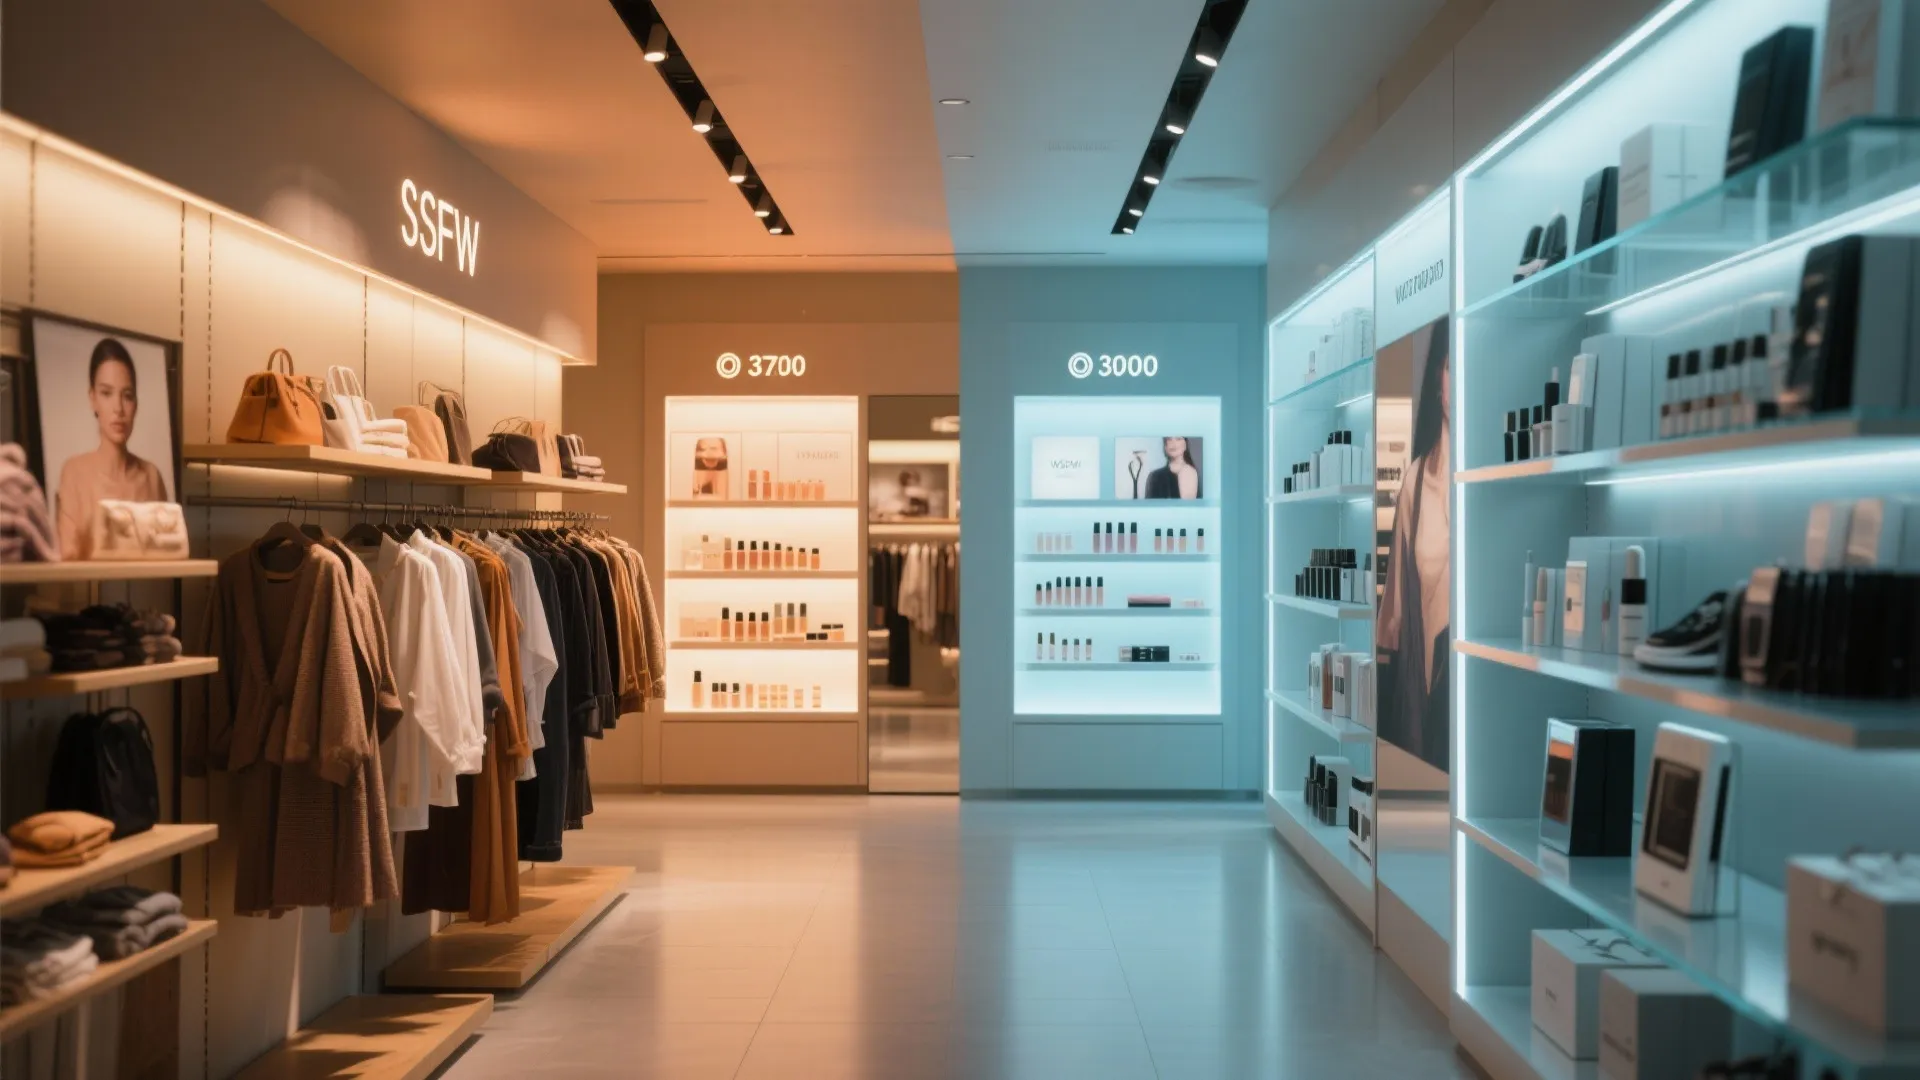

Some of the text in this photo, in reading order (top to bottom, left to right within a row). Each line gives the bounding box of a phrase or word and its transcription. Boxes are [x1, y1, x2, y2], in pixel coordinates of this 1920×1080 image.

[401, 178, 480, 277] SSFW
[747, 354, 806, 377] 3700
[1098, 354, 1158, 377] 3000
